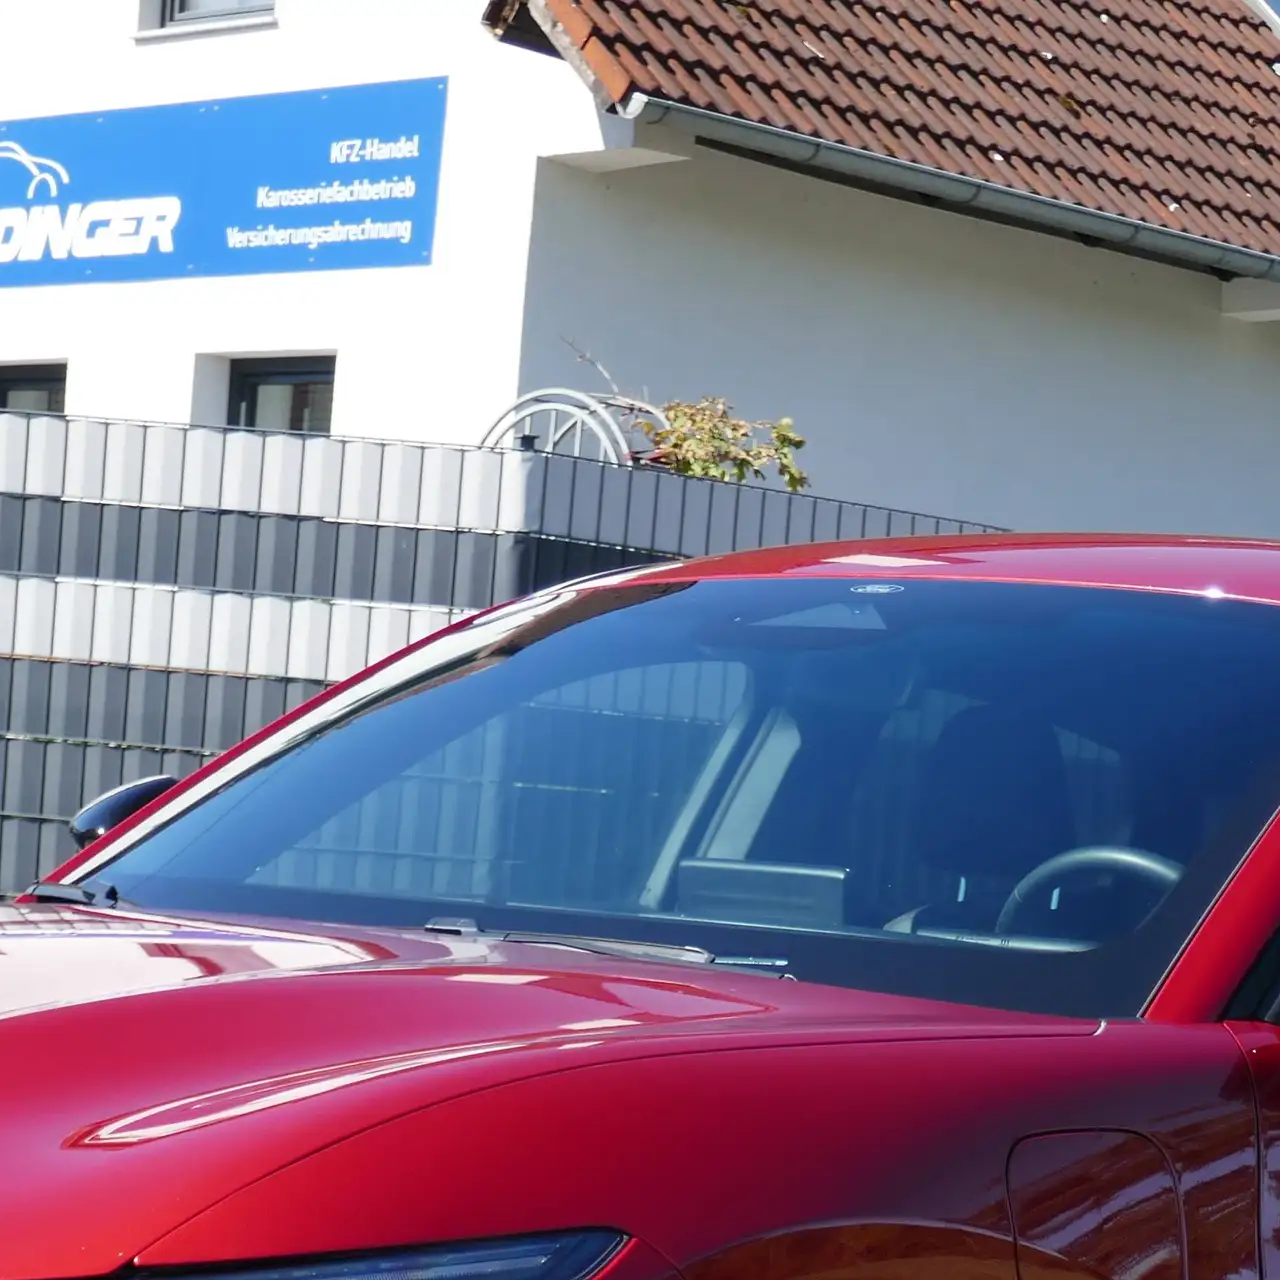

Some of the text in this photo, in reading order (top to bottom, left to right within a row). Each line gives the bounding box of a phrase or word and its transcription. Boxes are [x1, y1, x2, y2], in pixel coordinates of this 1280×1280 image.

[330, 135, 419, 163] KFZ-Handel
[257, 175, 415, 207] Karosseriefachbetrieb
[226, 218, 412, 248] Versicherungsabrechnung
